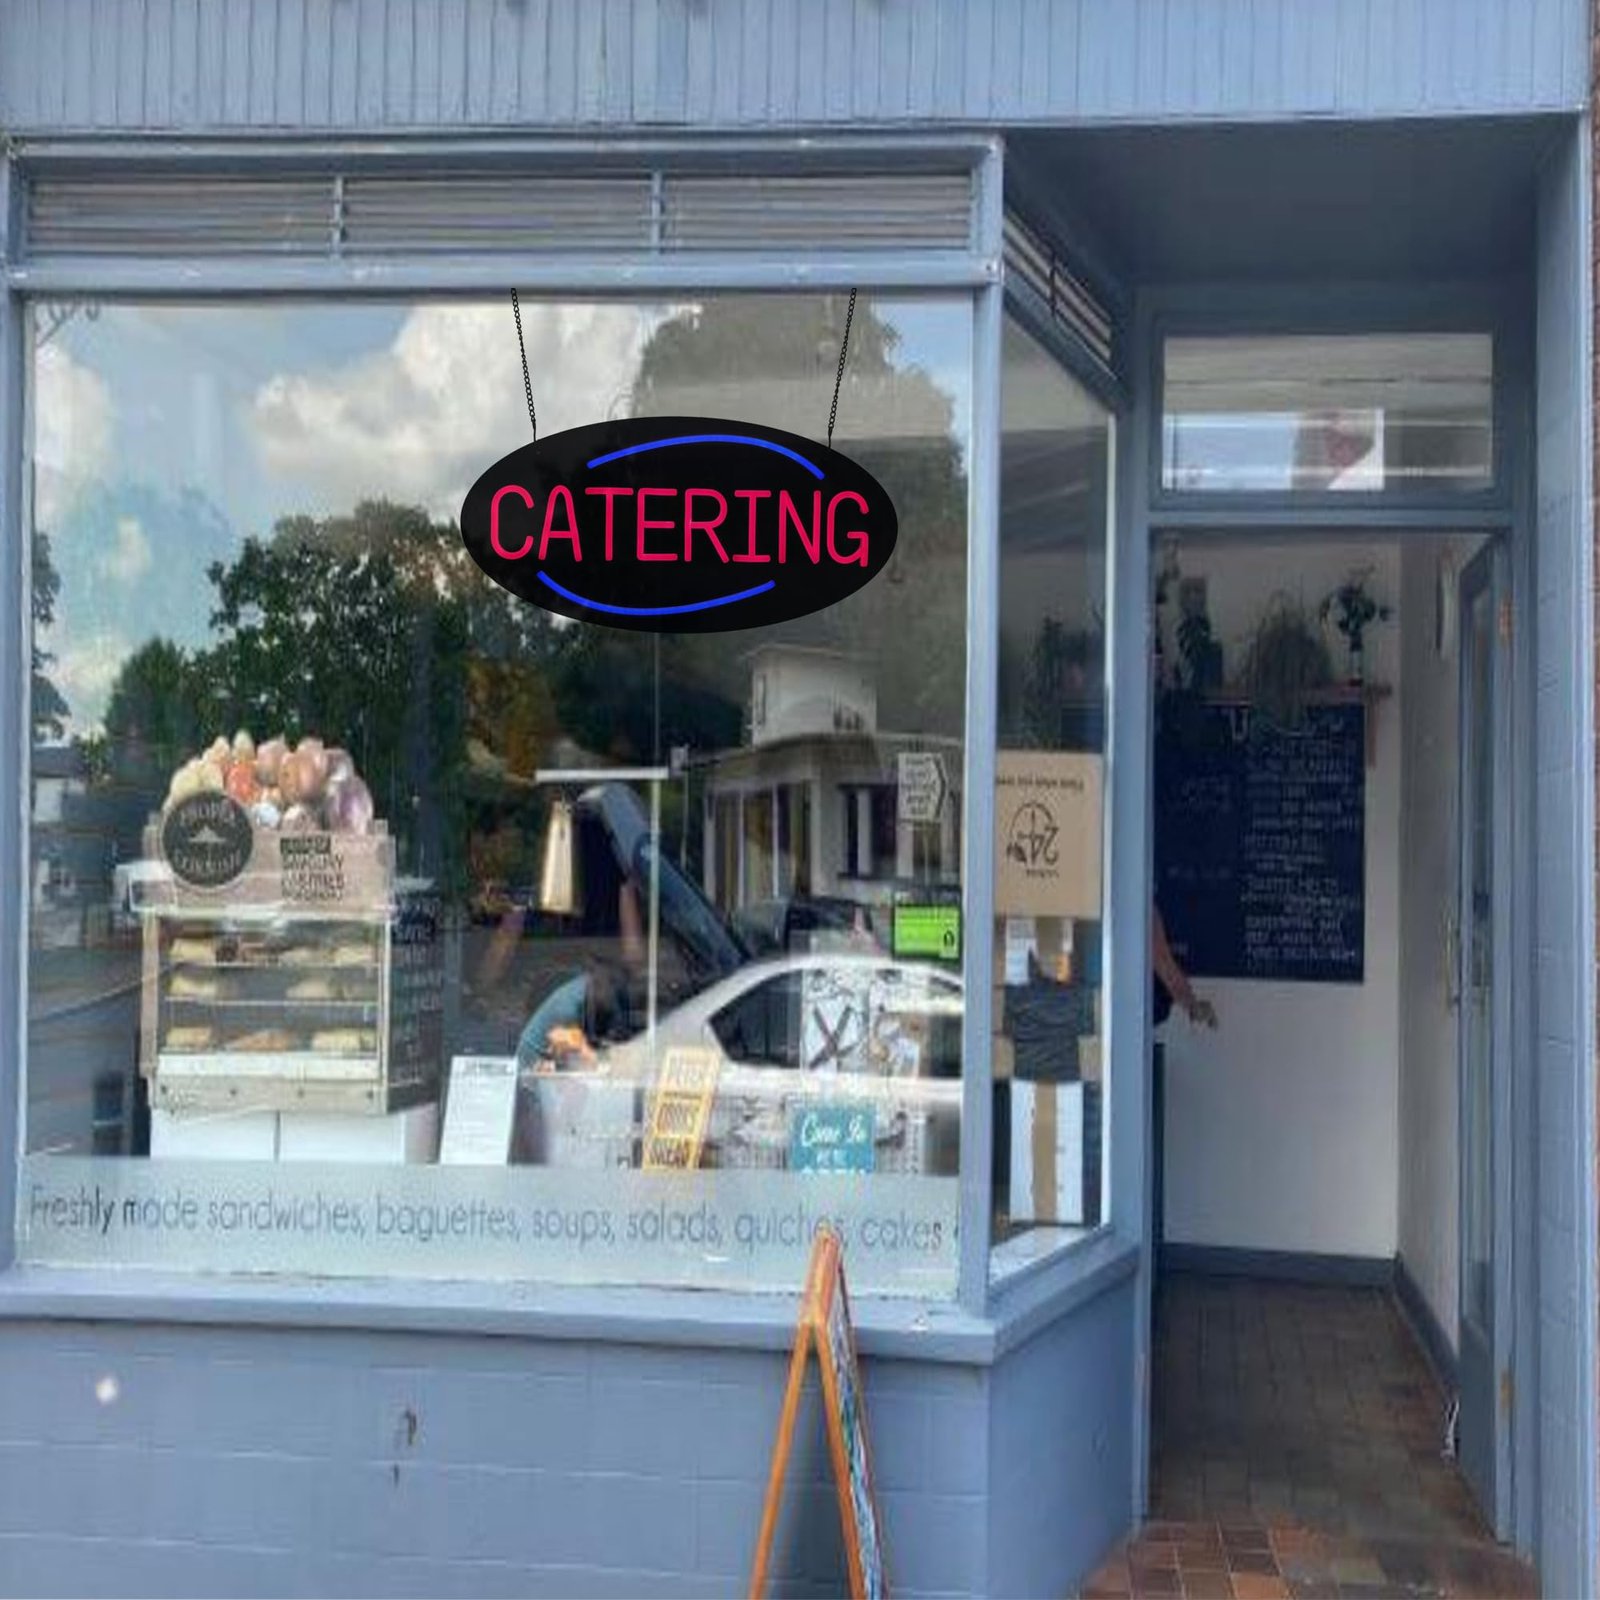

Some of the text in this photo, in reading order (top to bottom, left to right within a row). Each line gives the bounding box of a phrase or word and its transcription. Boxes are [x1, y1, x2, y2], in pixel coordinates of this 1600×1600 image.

[489, 484, 870, 567] CATERING
[31, 1184, 115, 1235] Freshly
[122, 1189, 199, 1231] made
[207, 1189, 366, 1239] sandwiches,
[375, 1192, 522, 1243] baguettes,
[532, 1207, 616, 1248] soups,
[626, 1200, 723, 1248] salads,
[860, 1211, 943, 1251] cakes
